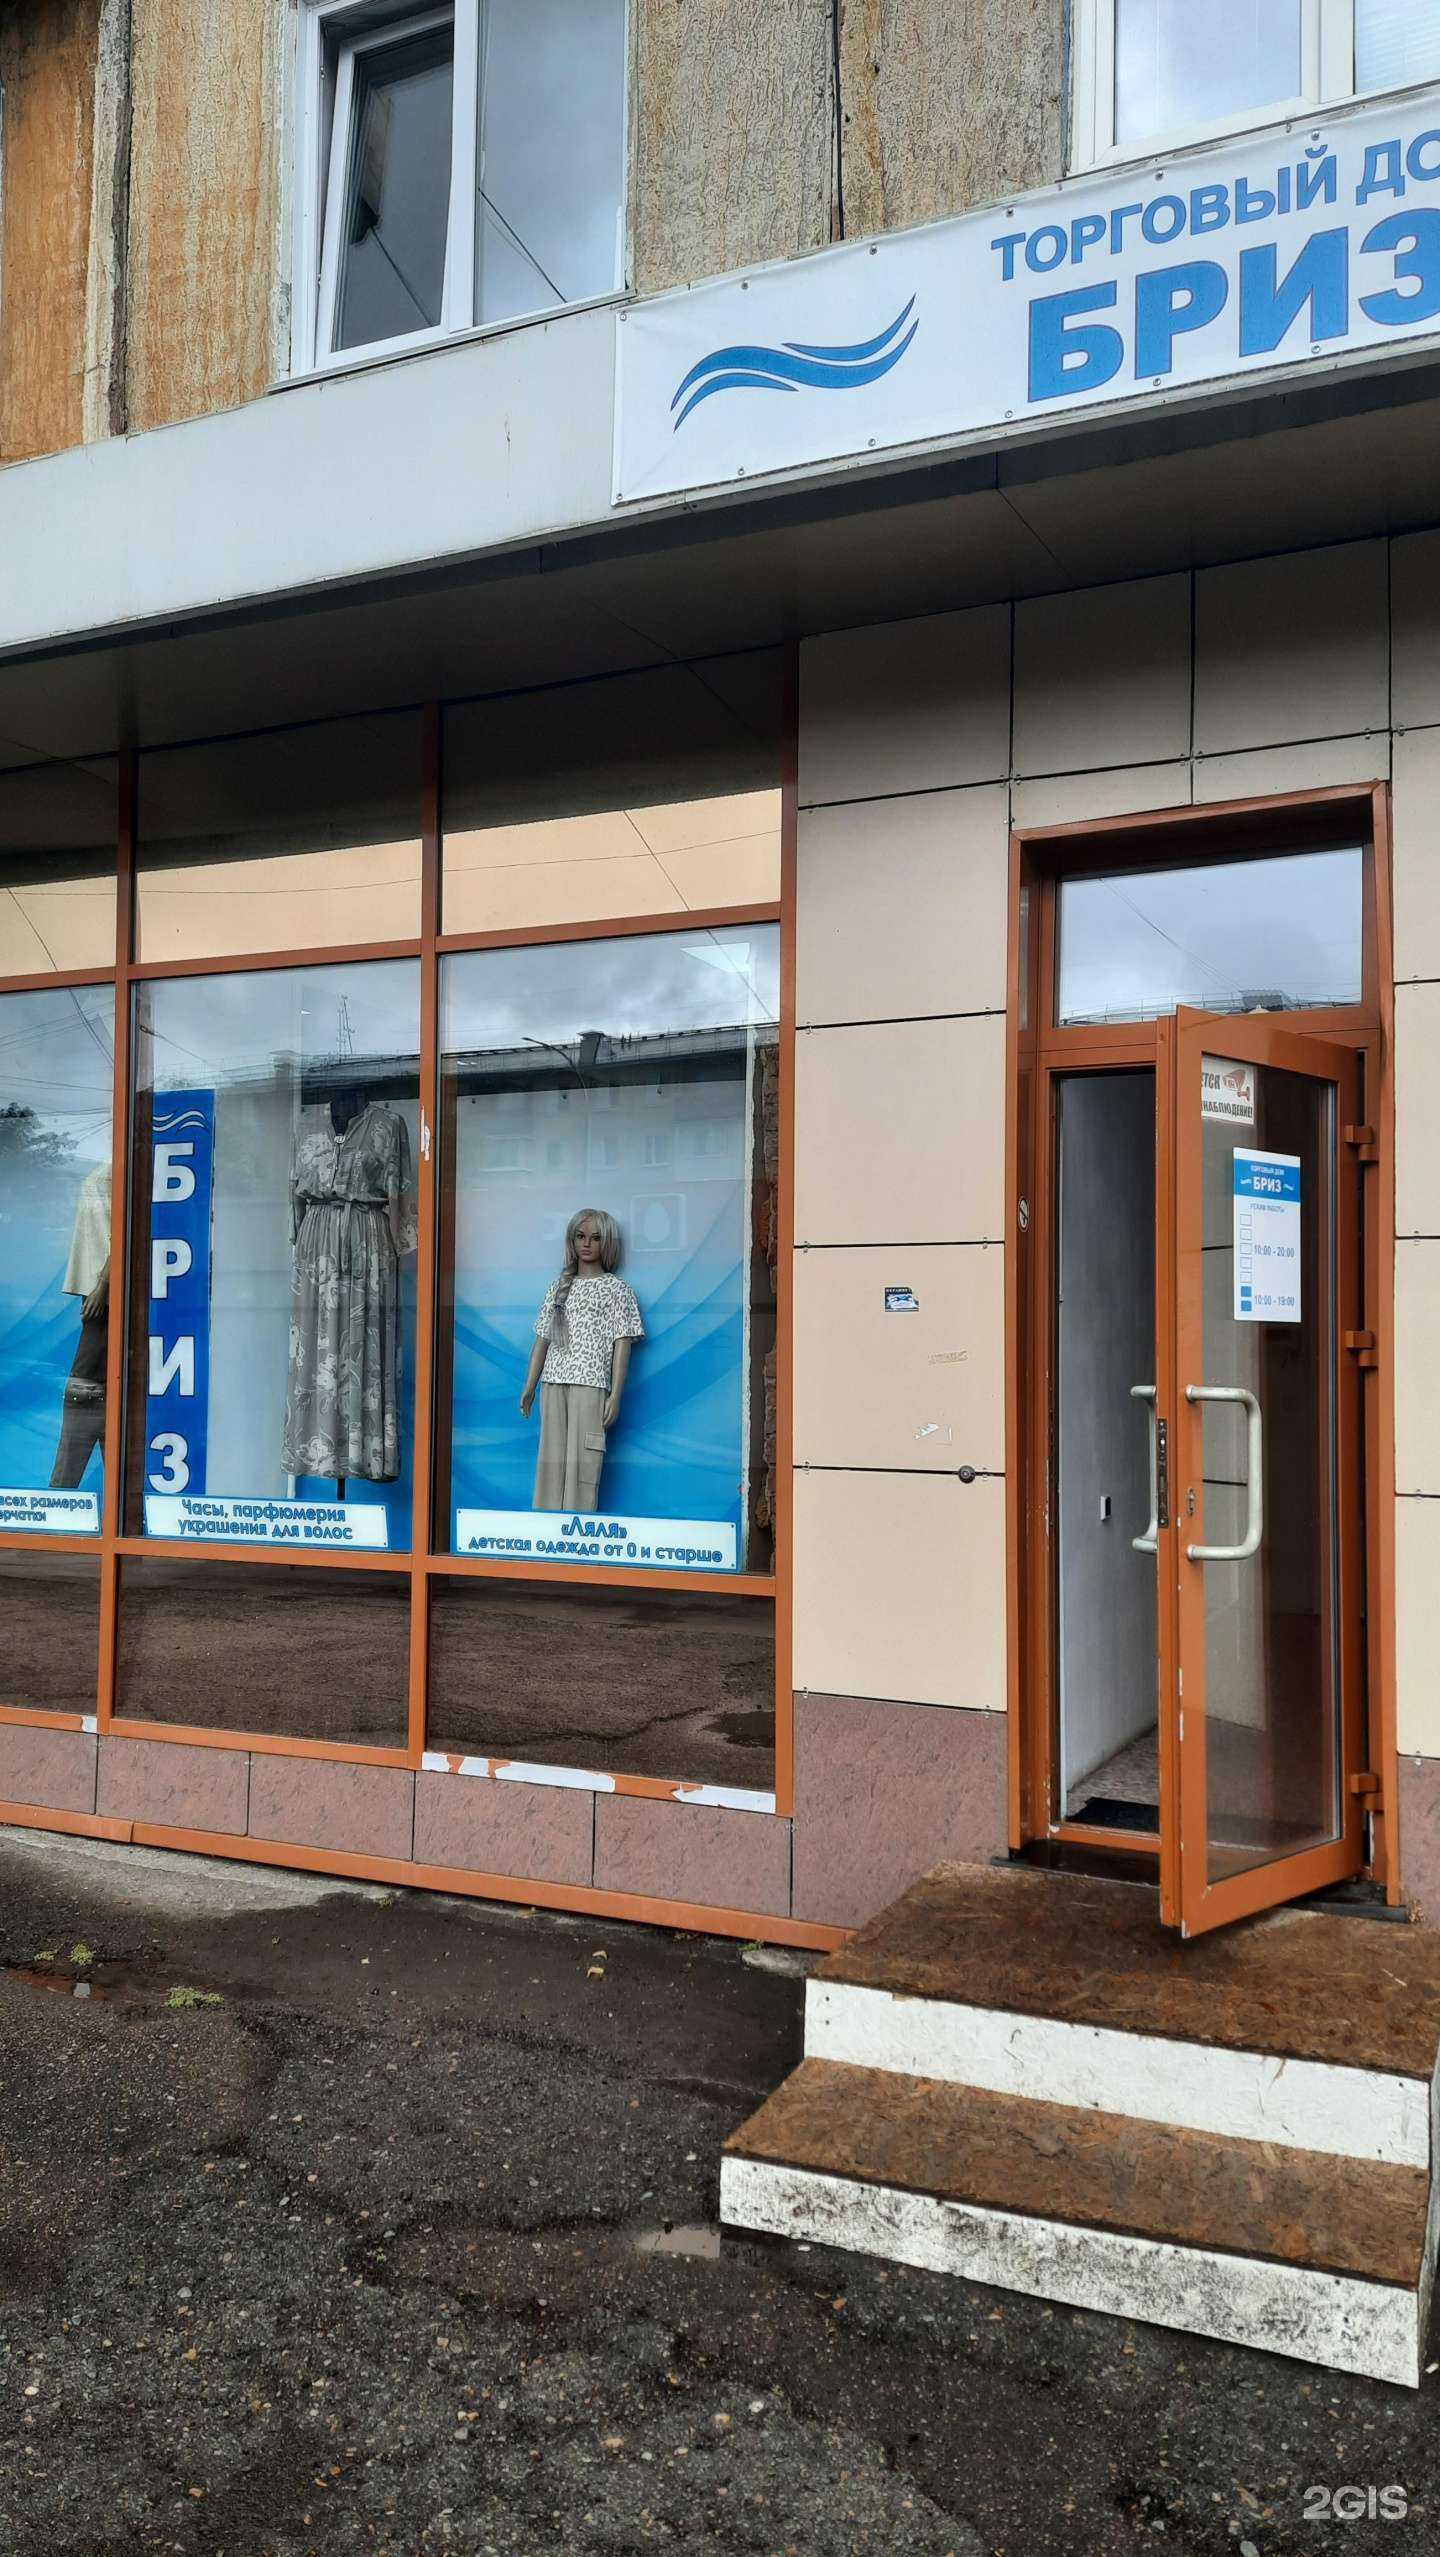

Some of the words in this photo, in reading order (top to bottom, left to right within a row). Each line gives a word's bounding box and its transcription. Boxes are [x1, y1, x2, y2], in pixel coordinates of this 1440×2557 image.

[991, 144, 1337, 281] ТОРГОВЫЙ
[1028, 208, 1440, 403] БРИЗ
[1253, 1176, 1282, 1193] БРИЗ
[1254, 1245, 1271, 1256] 10:00
[1277, 1246, 1295, 1258] 20:00
[1254, 1295, 1272, 1306] 10:00
[148, 1142, 197, 1494] БРИЗ
[30, 1497, 93, 1511] размеров
[182, 1499, 228, 1518] Часы,
[233, 1503, 346, 1524] парфюмерия
[178, 1519, 268, 1535] украшения
[272, 1525, 300, 1538] для
[304, 1526, 353, 1539] волос
[468, 1537, 532, 1551] детская
[536, 1541, 599, 1556] одежда
[604, 1545, 623, 1556] от
[641, 1546, 651, 1558] и
[655, 1547, 723, 1564] старше
